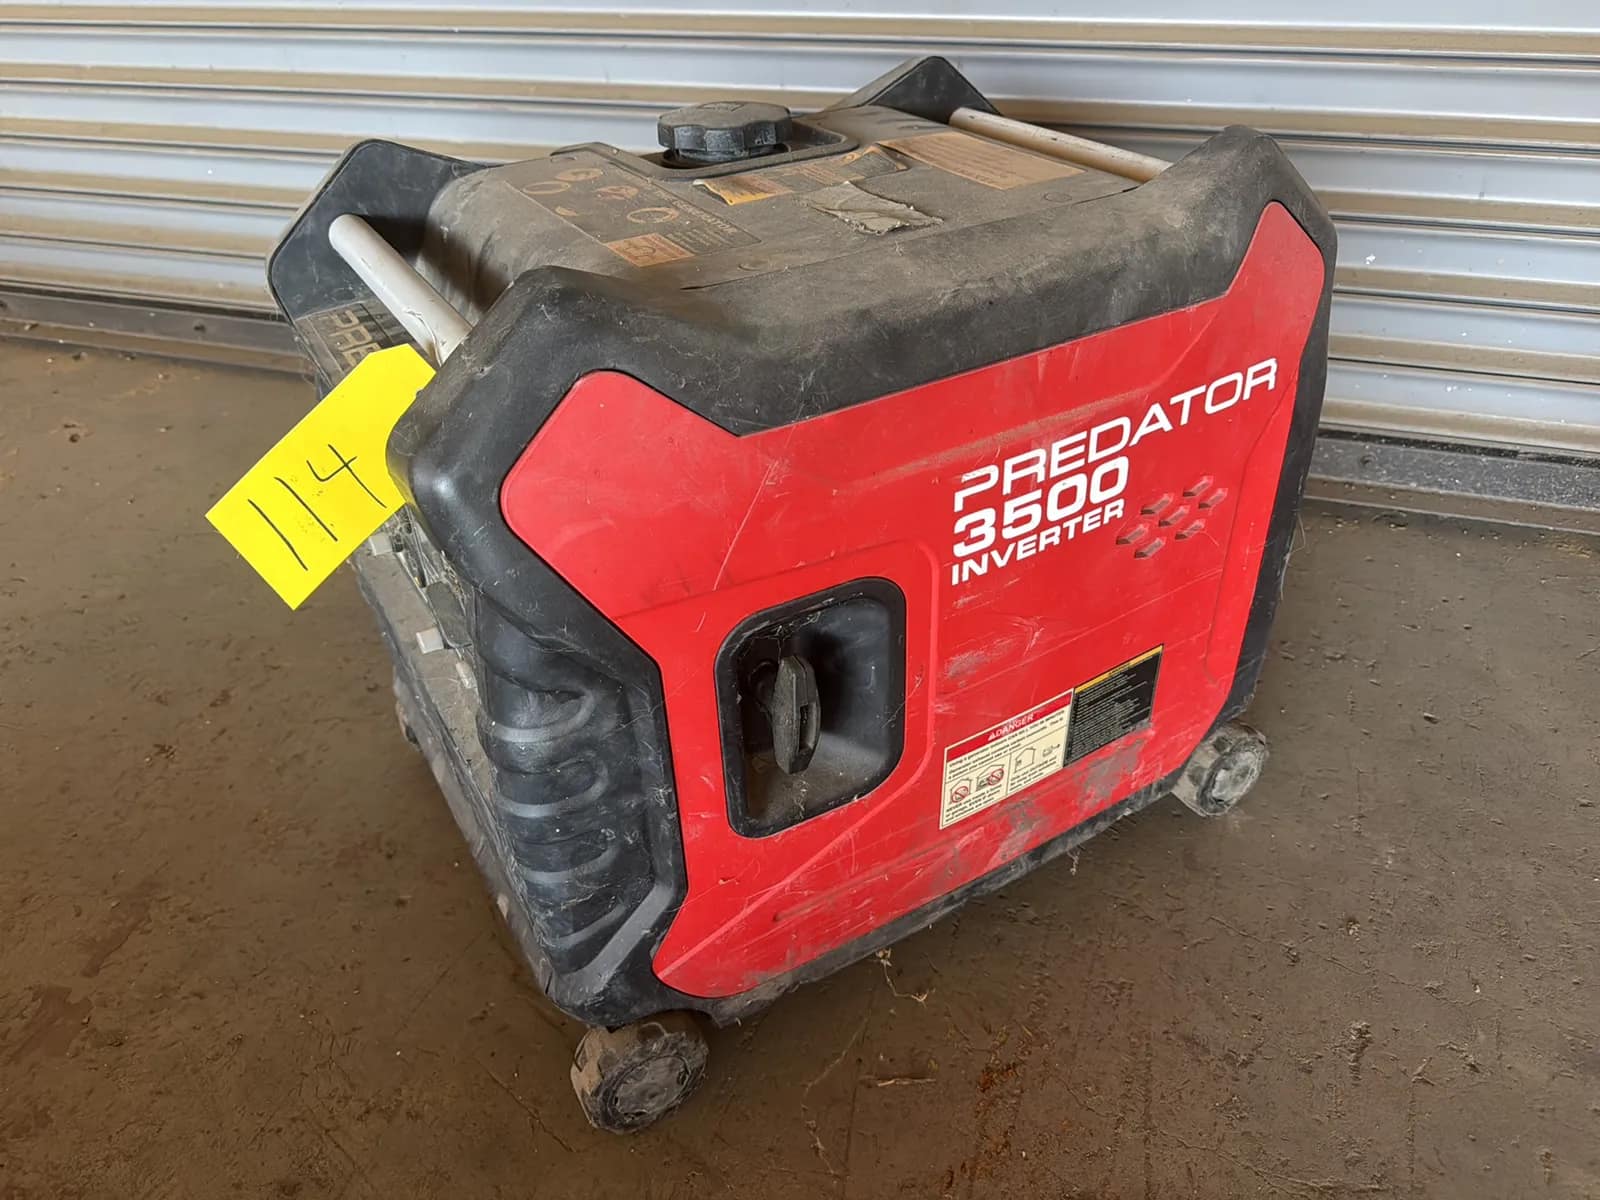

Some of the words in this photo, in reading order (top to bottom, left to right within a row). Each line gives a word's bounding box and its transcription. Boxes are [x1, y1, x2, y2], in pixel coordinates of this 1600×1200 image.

[953, 357, 1278, 513] PREDATOR
[247, 443, 388, 571] 114
[951, 498, 1126, 586] INVERTER
[952, 455, 1130, 558] 3500
[995, 713, 1035, 738] DANGER
